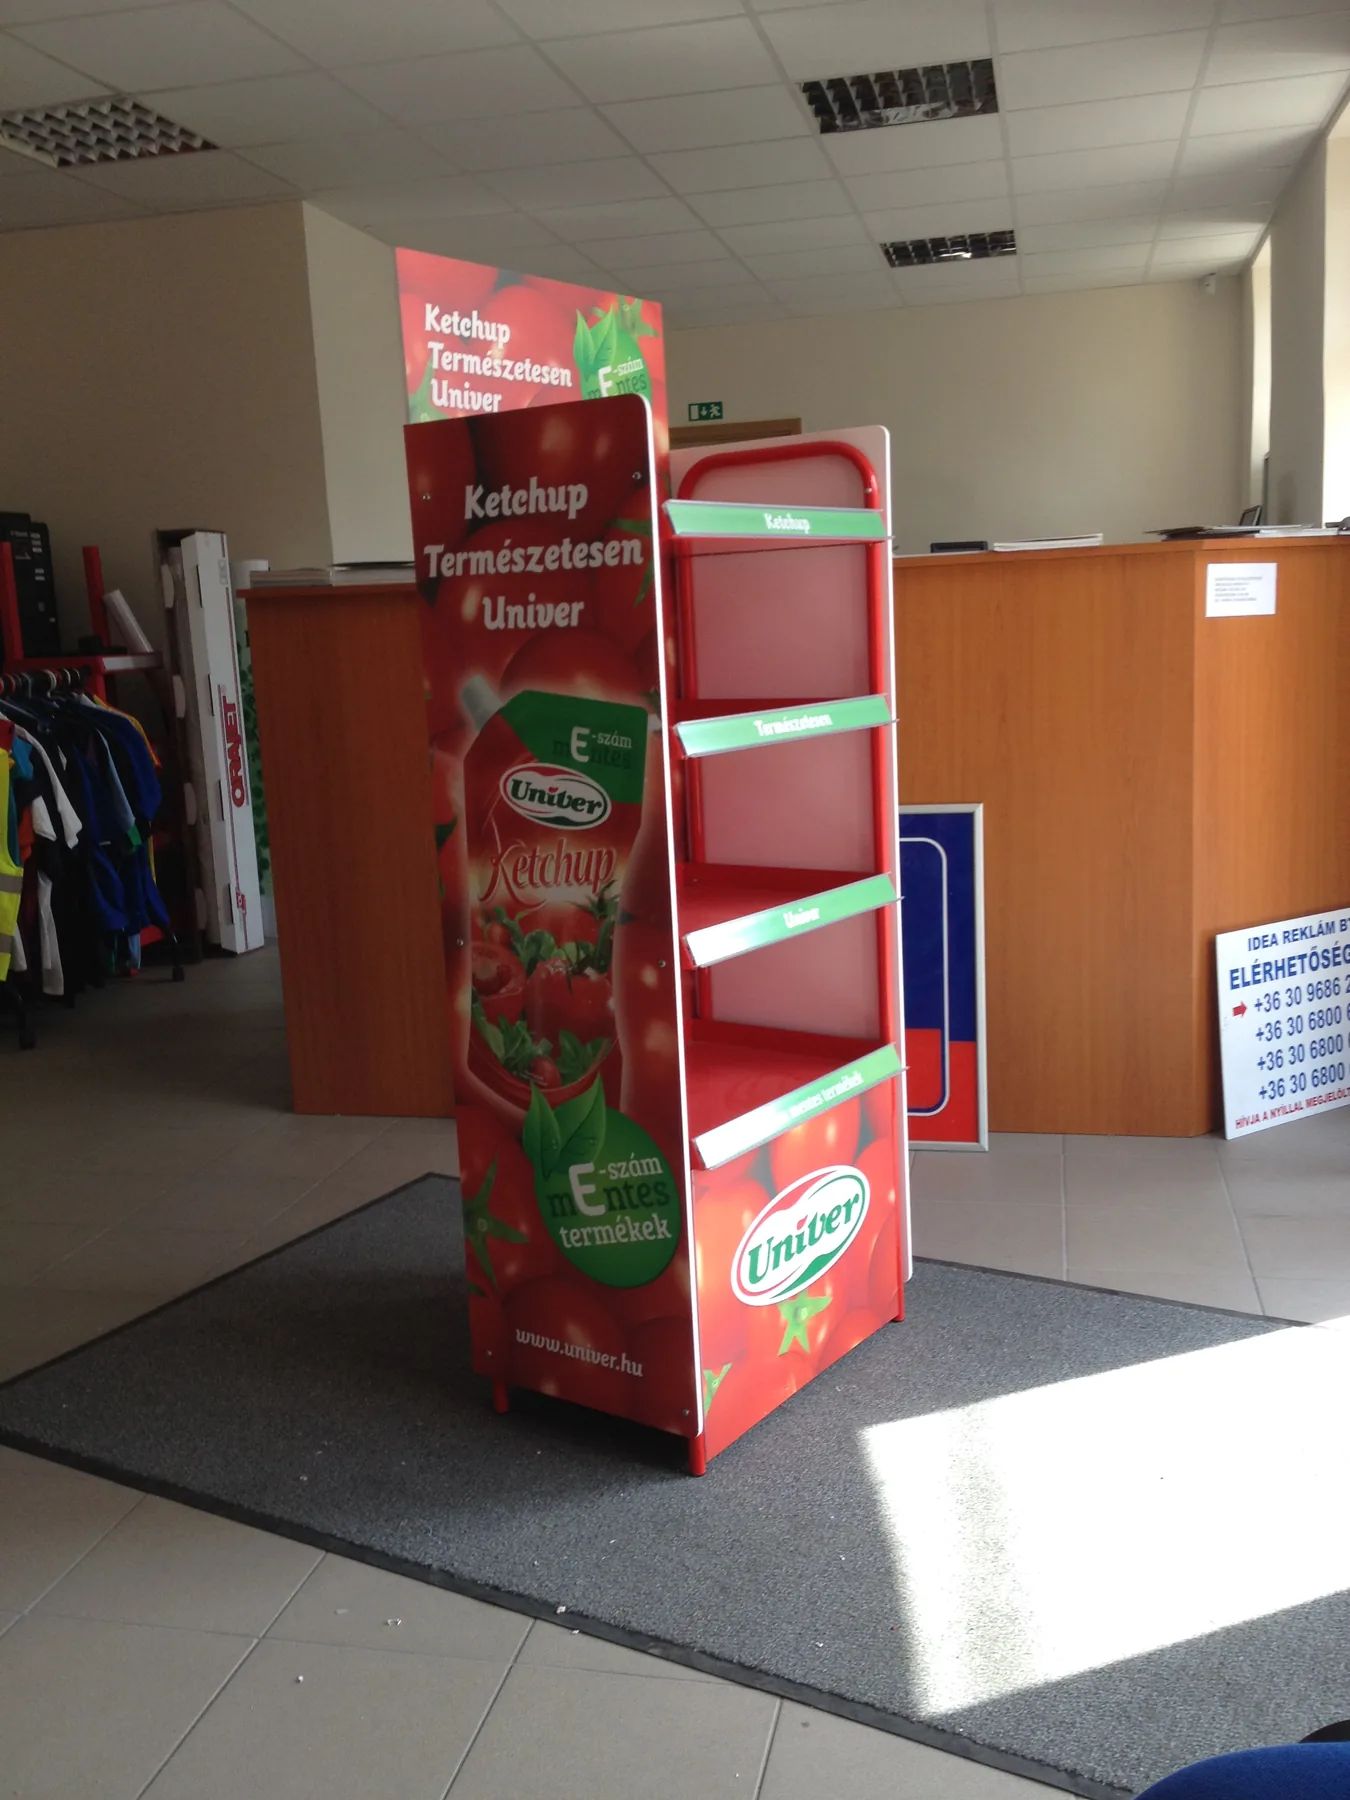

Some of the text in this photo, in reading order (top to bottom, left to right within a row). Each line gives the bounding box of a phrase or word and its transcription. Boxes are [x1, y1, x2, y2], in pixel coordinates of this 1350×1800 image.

[425, 303, 511, 348] Ketchup
[428, 341, 573, 388] Természetesen
[430, 378, 502, 413] Univer
[464, 476, 588, 520] Ketchup
[763, 513, 811, 534] Ketchup
[423, 537, 644, 578] Természetesen
[482, 592, 585, 630] Univer
[222, 695, 246, 808] ORAJET
[511, 778, 603, 815] Univer
[479, 837, 617, 909] Ketchup
[1248, 933, 1279, 951] IDEA
[1282, 920, 1335, 944] REKLÁM
[1254, 991, 1281, 1013] +36
[1285, 986, 1302, 1007] 30
[1307, 977, 1341, 1002] 9686
[1256, 1020, 1282, 1042] +36
[1287, 1014, 1303, 1036] 30
[1308, 1005, 1342, 1031] 6800
[1257, 1033, 1343, 1071] +36 30 6800
[1259, 1062, 1345, 1101] +36 30 6800
[1235, 1113, 1260, 1129] HÍVJA
[1262, 1111, 1269, 1121] A
[1270, 1101, 1304, 1119] NYÍLLAL
[559, 1213, 672, 1249] termékek
[747, 1192, 860, 1285] Univer
[516, 1328, 643, 1377] www.univer.hu
